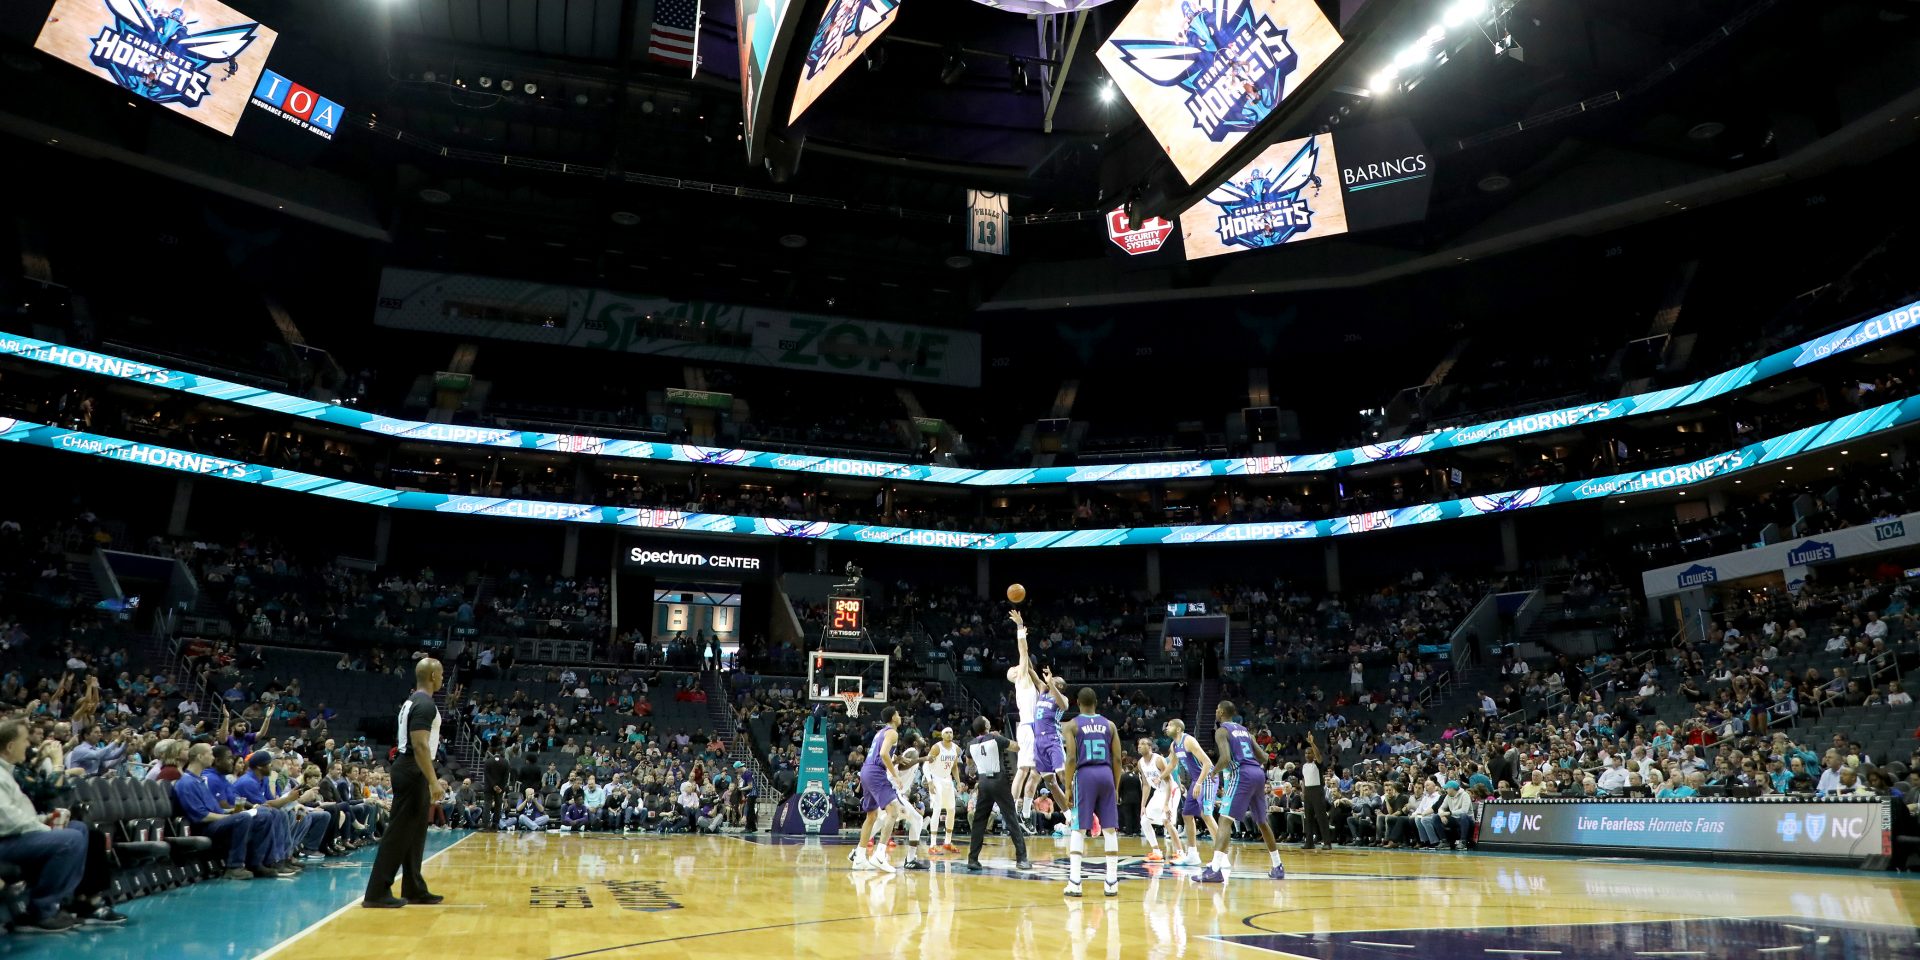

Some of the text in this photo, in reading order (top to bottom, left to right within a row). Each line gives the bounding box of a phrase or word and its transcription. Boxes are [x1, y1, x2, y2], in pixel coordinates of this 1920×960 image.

[251, 97, 332, 141] INSURANCE OFFICE OF AMERICA
[1343, 154, 1426, 185] BARINGS
[975, 208, 1000, 219] PHILLS
[1235, 200, 1289, 217] CHARLOTTE
[978, 220, 996, 246] 13
[1124, 230, 1160, 243] SECURITY
[1126, 238, 1161, 250] SYSTEMS
[1814, 344, 1830, 357] LOS
[48, 346, 169, 383] HORNETS
[1457, 402, 1611, 443] CHARLOTTE HORNETS
[380, 423, 394, 433] LOS
[426, 425, 511, 443] CLIPPERS
[62, 435, 247, 478] CHARLOTTE HORNETS
[778, 458, 911, 478] CHARLOTTE HORNETS
[1125, 462, 1202, 479] CLIPPERS
[1582, 451, 1743, 496] CHARLOTTE HORNETS
[457, 503, 473, 511] LOS
[506, 503, 592, 520] CLIPPERS
[861, 530, 996, 548] CHARLOTTE HORNETS
[1181, 532, 1196, 540] LOS
[1225, 525, 1306, 540] CLIPPERS
[1876, 523, 1903, 539] 104
[630, 547, 760, 569] Spectrum CENTER
[1792, 546, 1832, 565] LOWE'S
[1680, 570, 1714, 587] LOWE'S
[836, 600, 860, 612] 12:00
[834, 611, 857, 628] 24
[1036, 708, 1044, 720] 8
[1081, 724, 1107, 735] WALKER
[980, 744, 987, 757] 4
[1083, 739, 1106, 760] 15
[1240, 741, 1254, 759] 2
[1522, 814, 1542, 831] NC
[1578, 816, 1725, 834] Live Fearless Hornets Fans
[1831, 816, 1864, 839] NC
